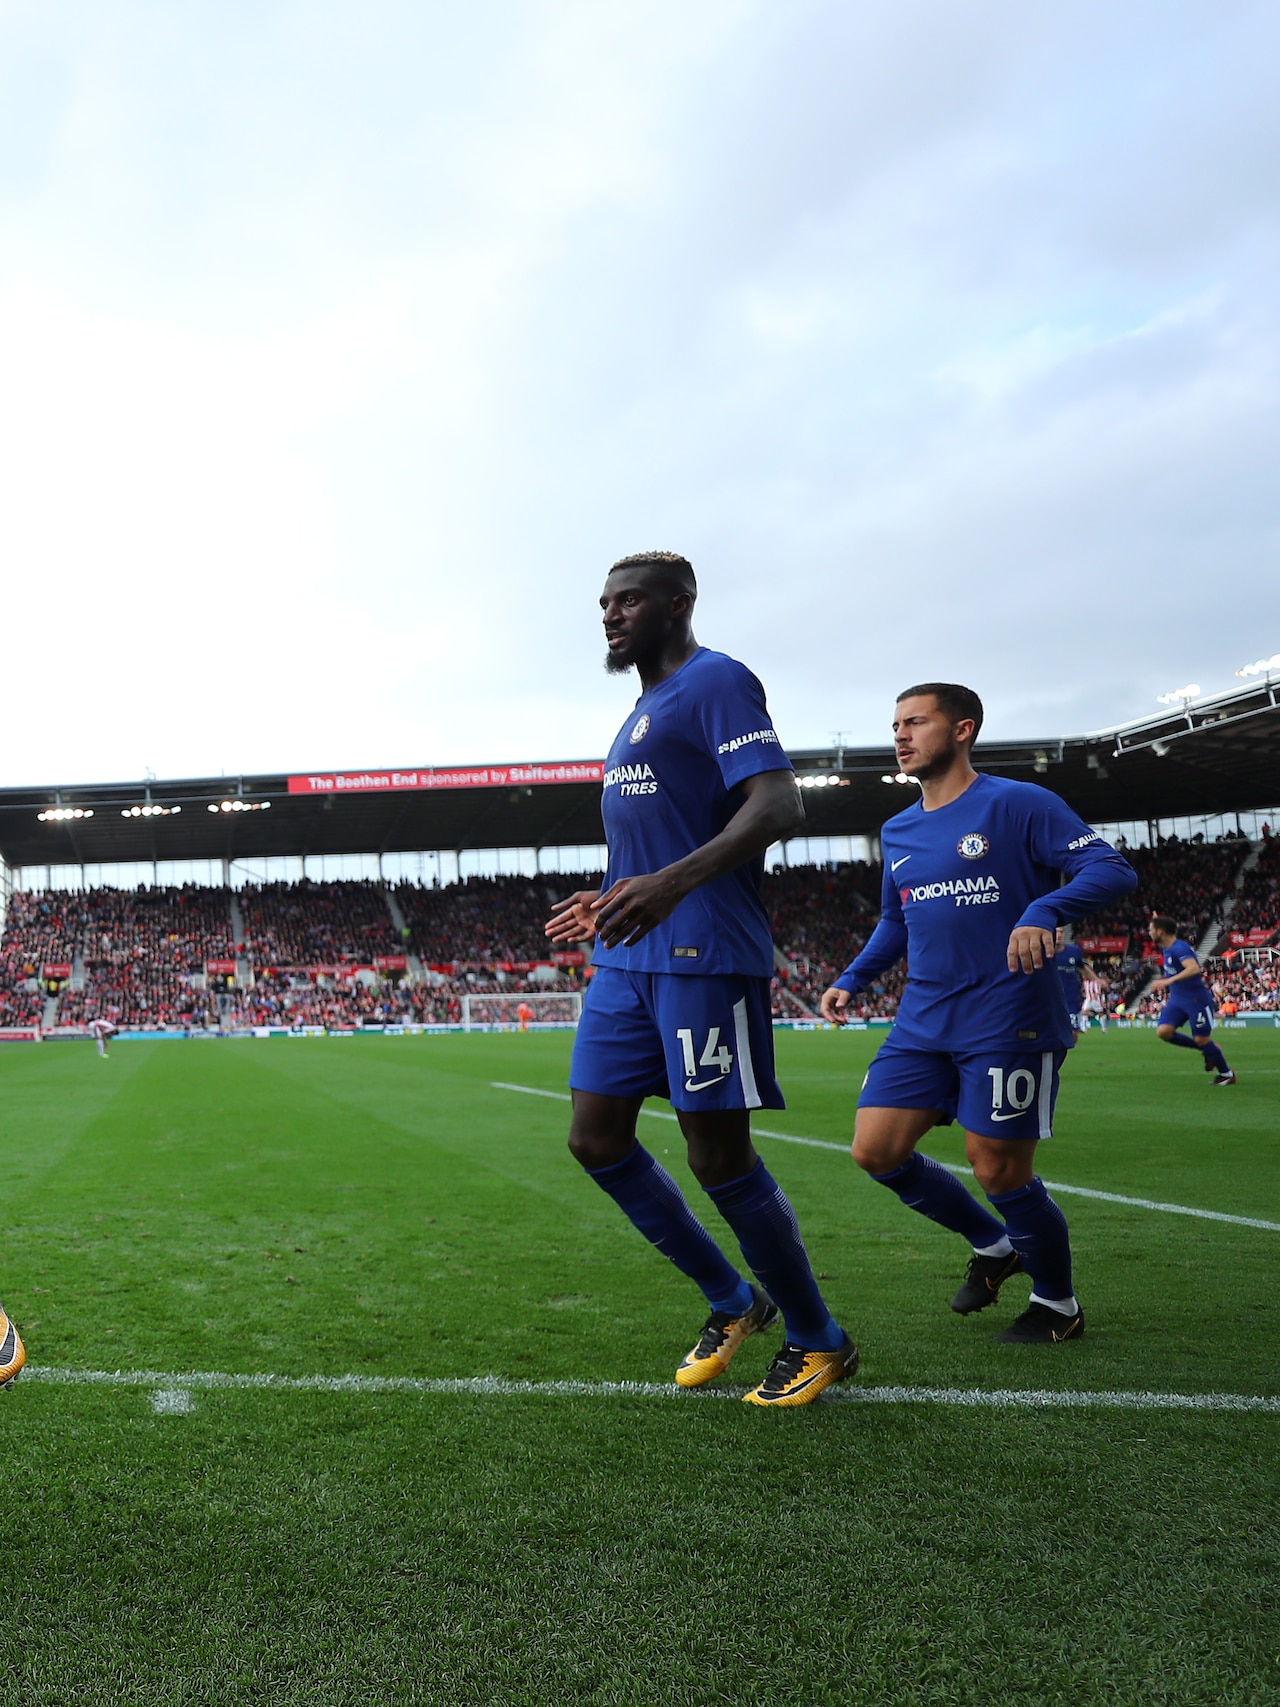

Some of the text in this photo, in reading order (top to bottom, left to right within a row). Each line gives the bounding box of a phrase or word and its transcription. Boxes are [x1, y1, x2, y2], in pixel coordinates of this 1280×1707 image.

[729, 729, 777, 753] ALLIANC
[308, 764, 600, 790] The Boothen End sponsored by Staffordshire
[620, 781, 658, 797] TYRES
[909, 876, 1000, 903] YOKOHAMA
[954, 892, 1000, 907] TYRES
[676, 1026, 734, 1077] 14
[987, 1067, 1036, 1110] 10
